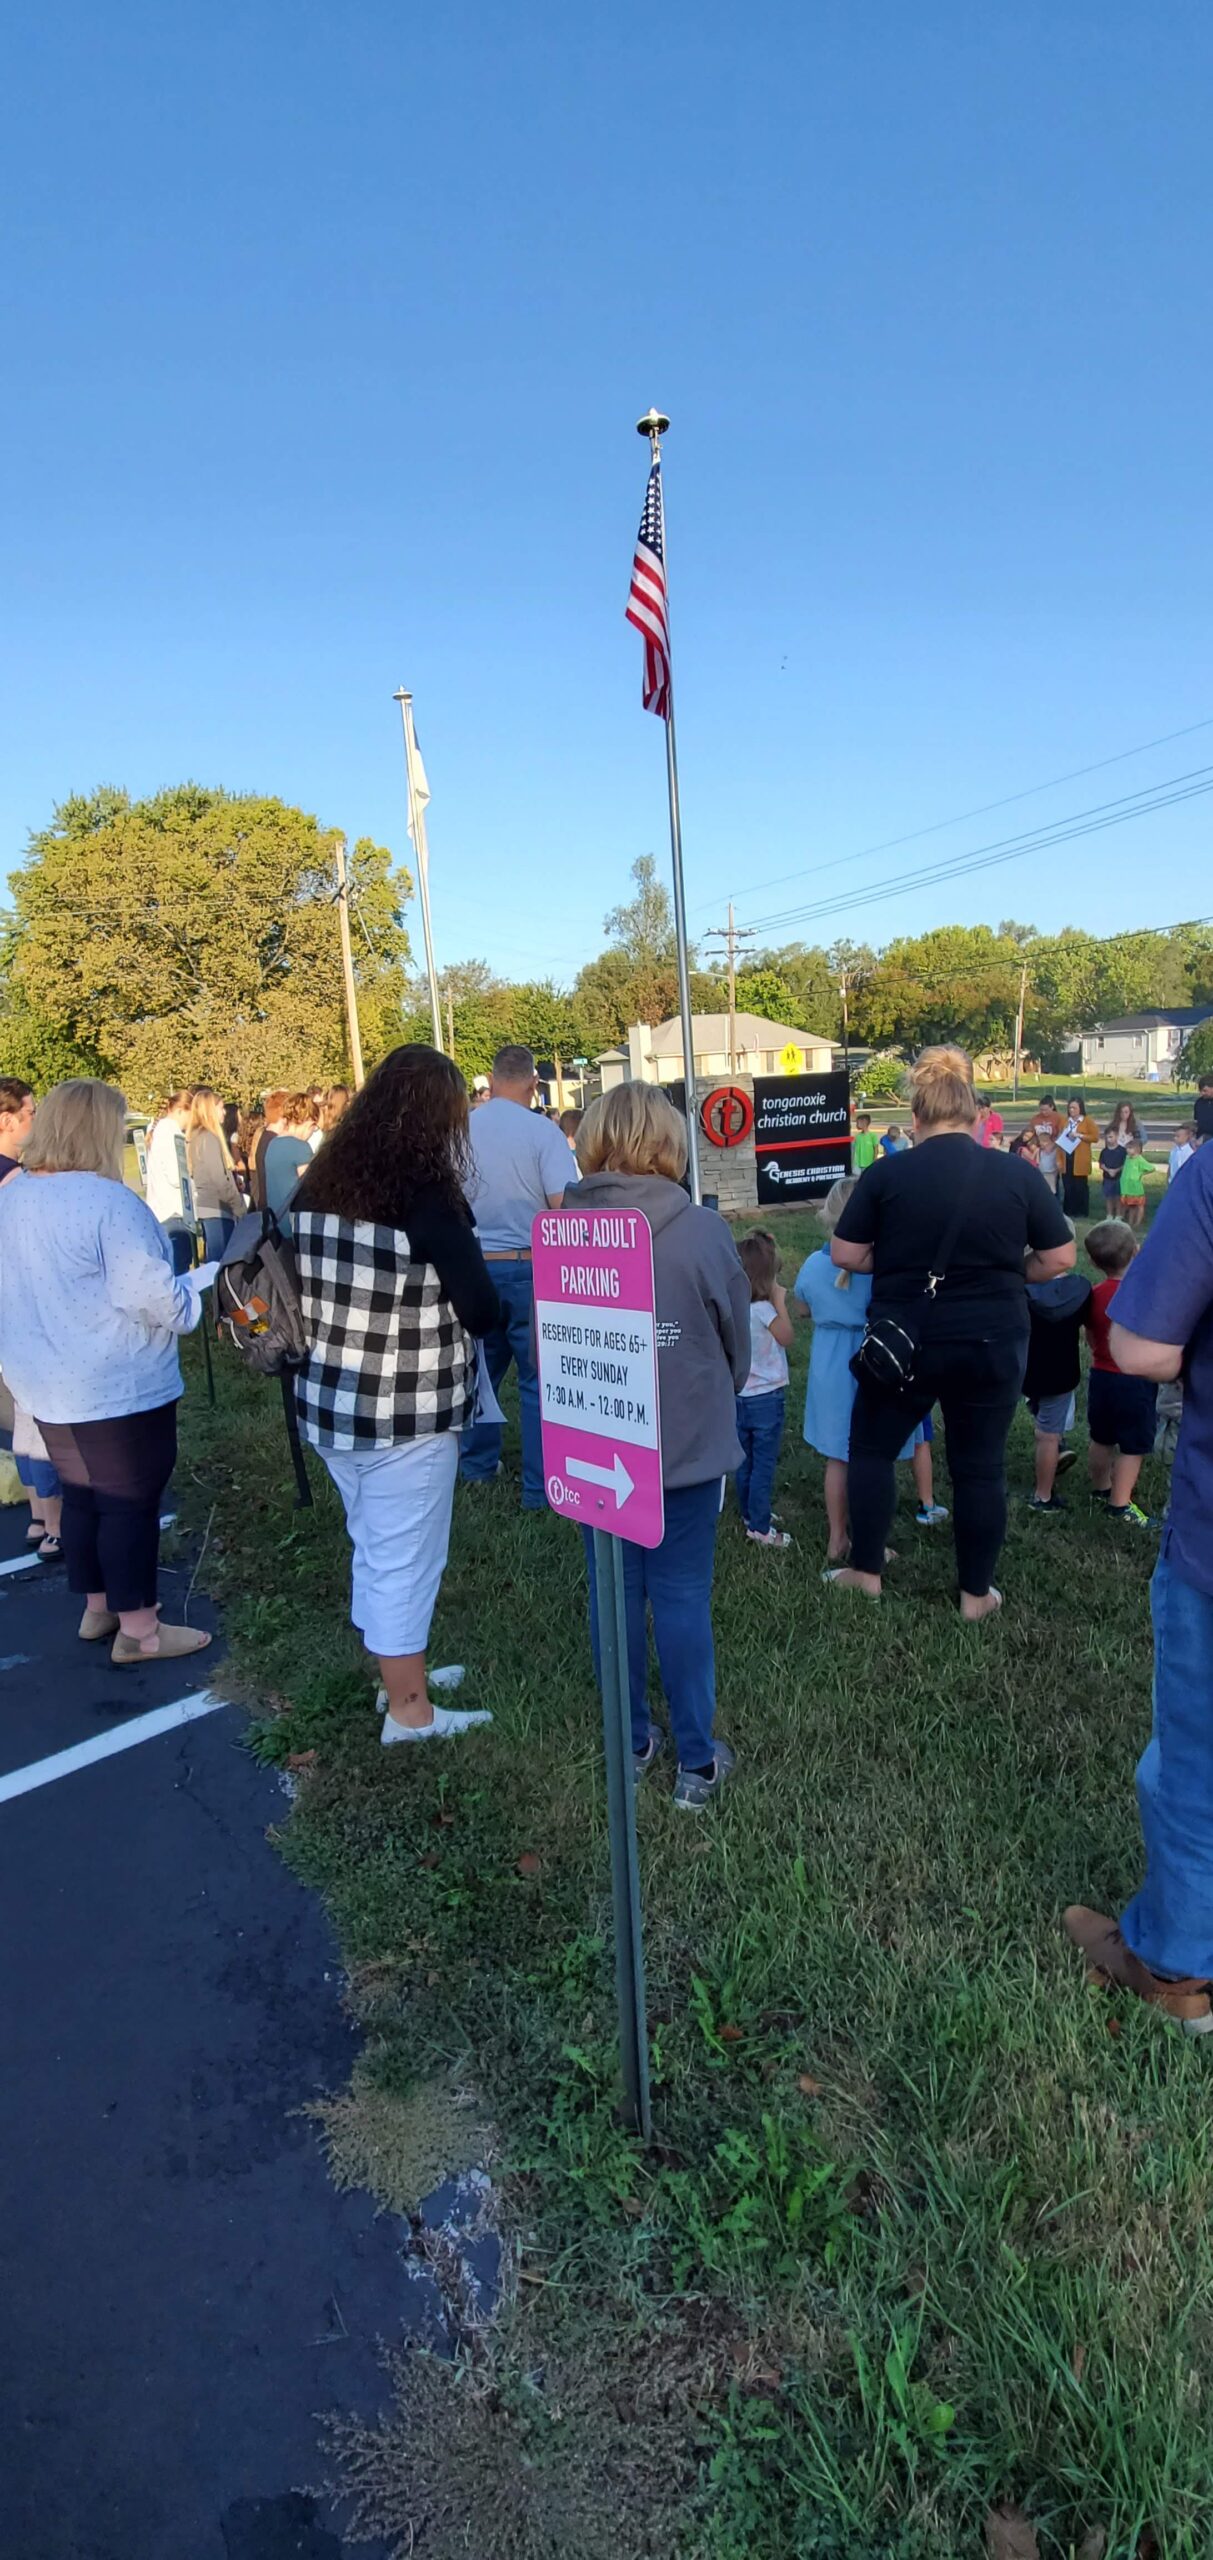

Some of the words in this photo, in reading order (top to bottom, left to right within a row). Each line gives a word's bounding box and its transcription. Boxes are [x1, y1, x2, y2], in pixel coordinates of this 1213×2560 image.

[762, 1092, 826, 1111] tonganoxie
[757, 1113, 806, 1129] christian
[809, 1108, 847, 1124] church
[541, 1218, 590, 1247] SENIOR
[592, 1218, 637, 1249] ADULT
[560, 1265, 620, 1298] PARKING
[542, 1322, 583, 1345] RESERVED
[584, 1328, 602, 1348] FOR
[603, 1331, 627, 1352] AGES
[628, 1334, 649, 1354] 65+
[560, 1355, 589, 1379] EVERY
[591, 1360, 629, 1387] SUNDAY
[546, 1383, 566, 1406] 7:30
[568, 1388, 588, 1411] A.M.
[598, 1394, 625, 1420] 12:00
[627, 1401, 649, 1426] P.M.
[564, 1486, 581, 1505] tcc
